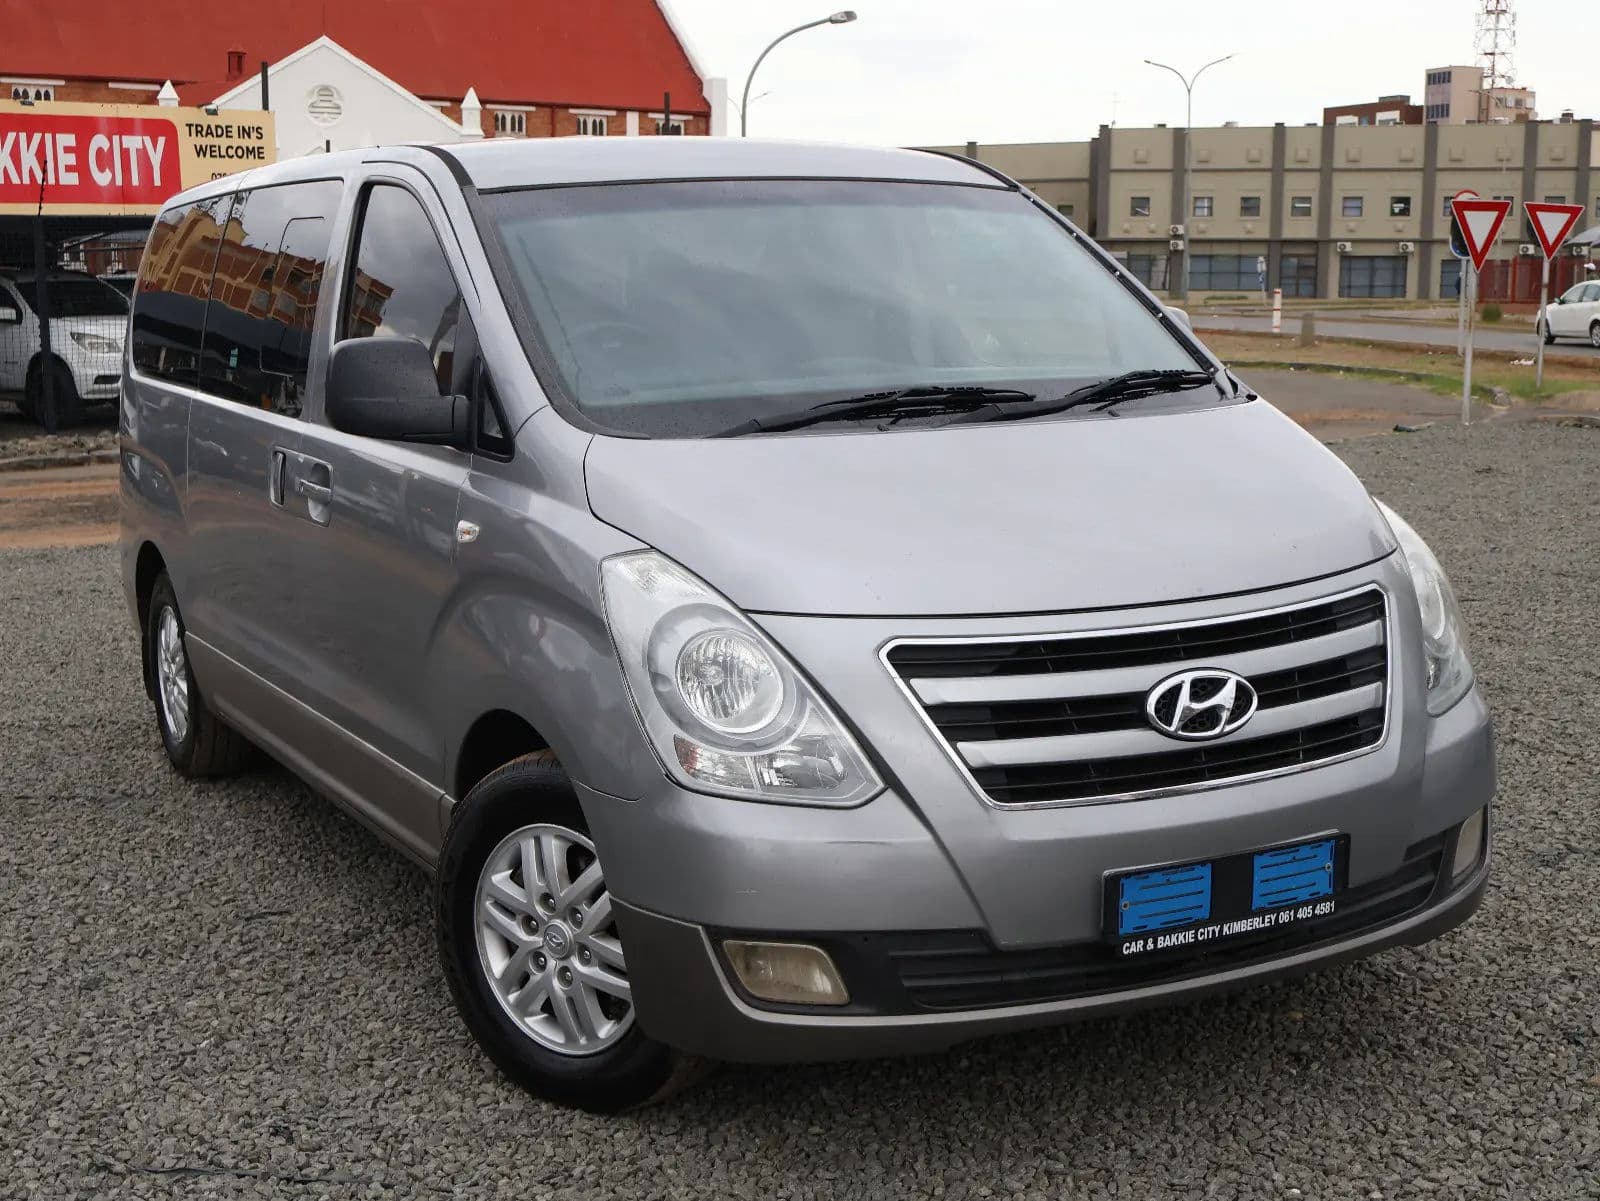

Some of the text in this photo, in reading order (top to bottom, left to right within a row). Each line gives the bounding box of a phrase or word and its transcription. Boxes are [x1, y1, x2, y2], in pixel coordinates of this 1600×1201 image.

[185, 123, 264, 140] TRADE IN'S
[0, 131, 166, 187] KKIE CITY
[194, 143, 265, 160] WELCOME
[1122, 900, 1335, 955] CAR & BAKKIE CITY KIMBERLEY 061 405 4581
